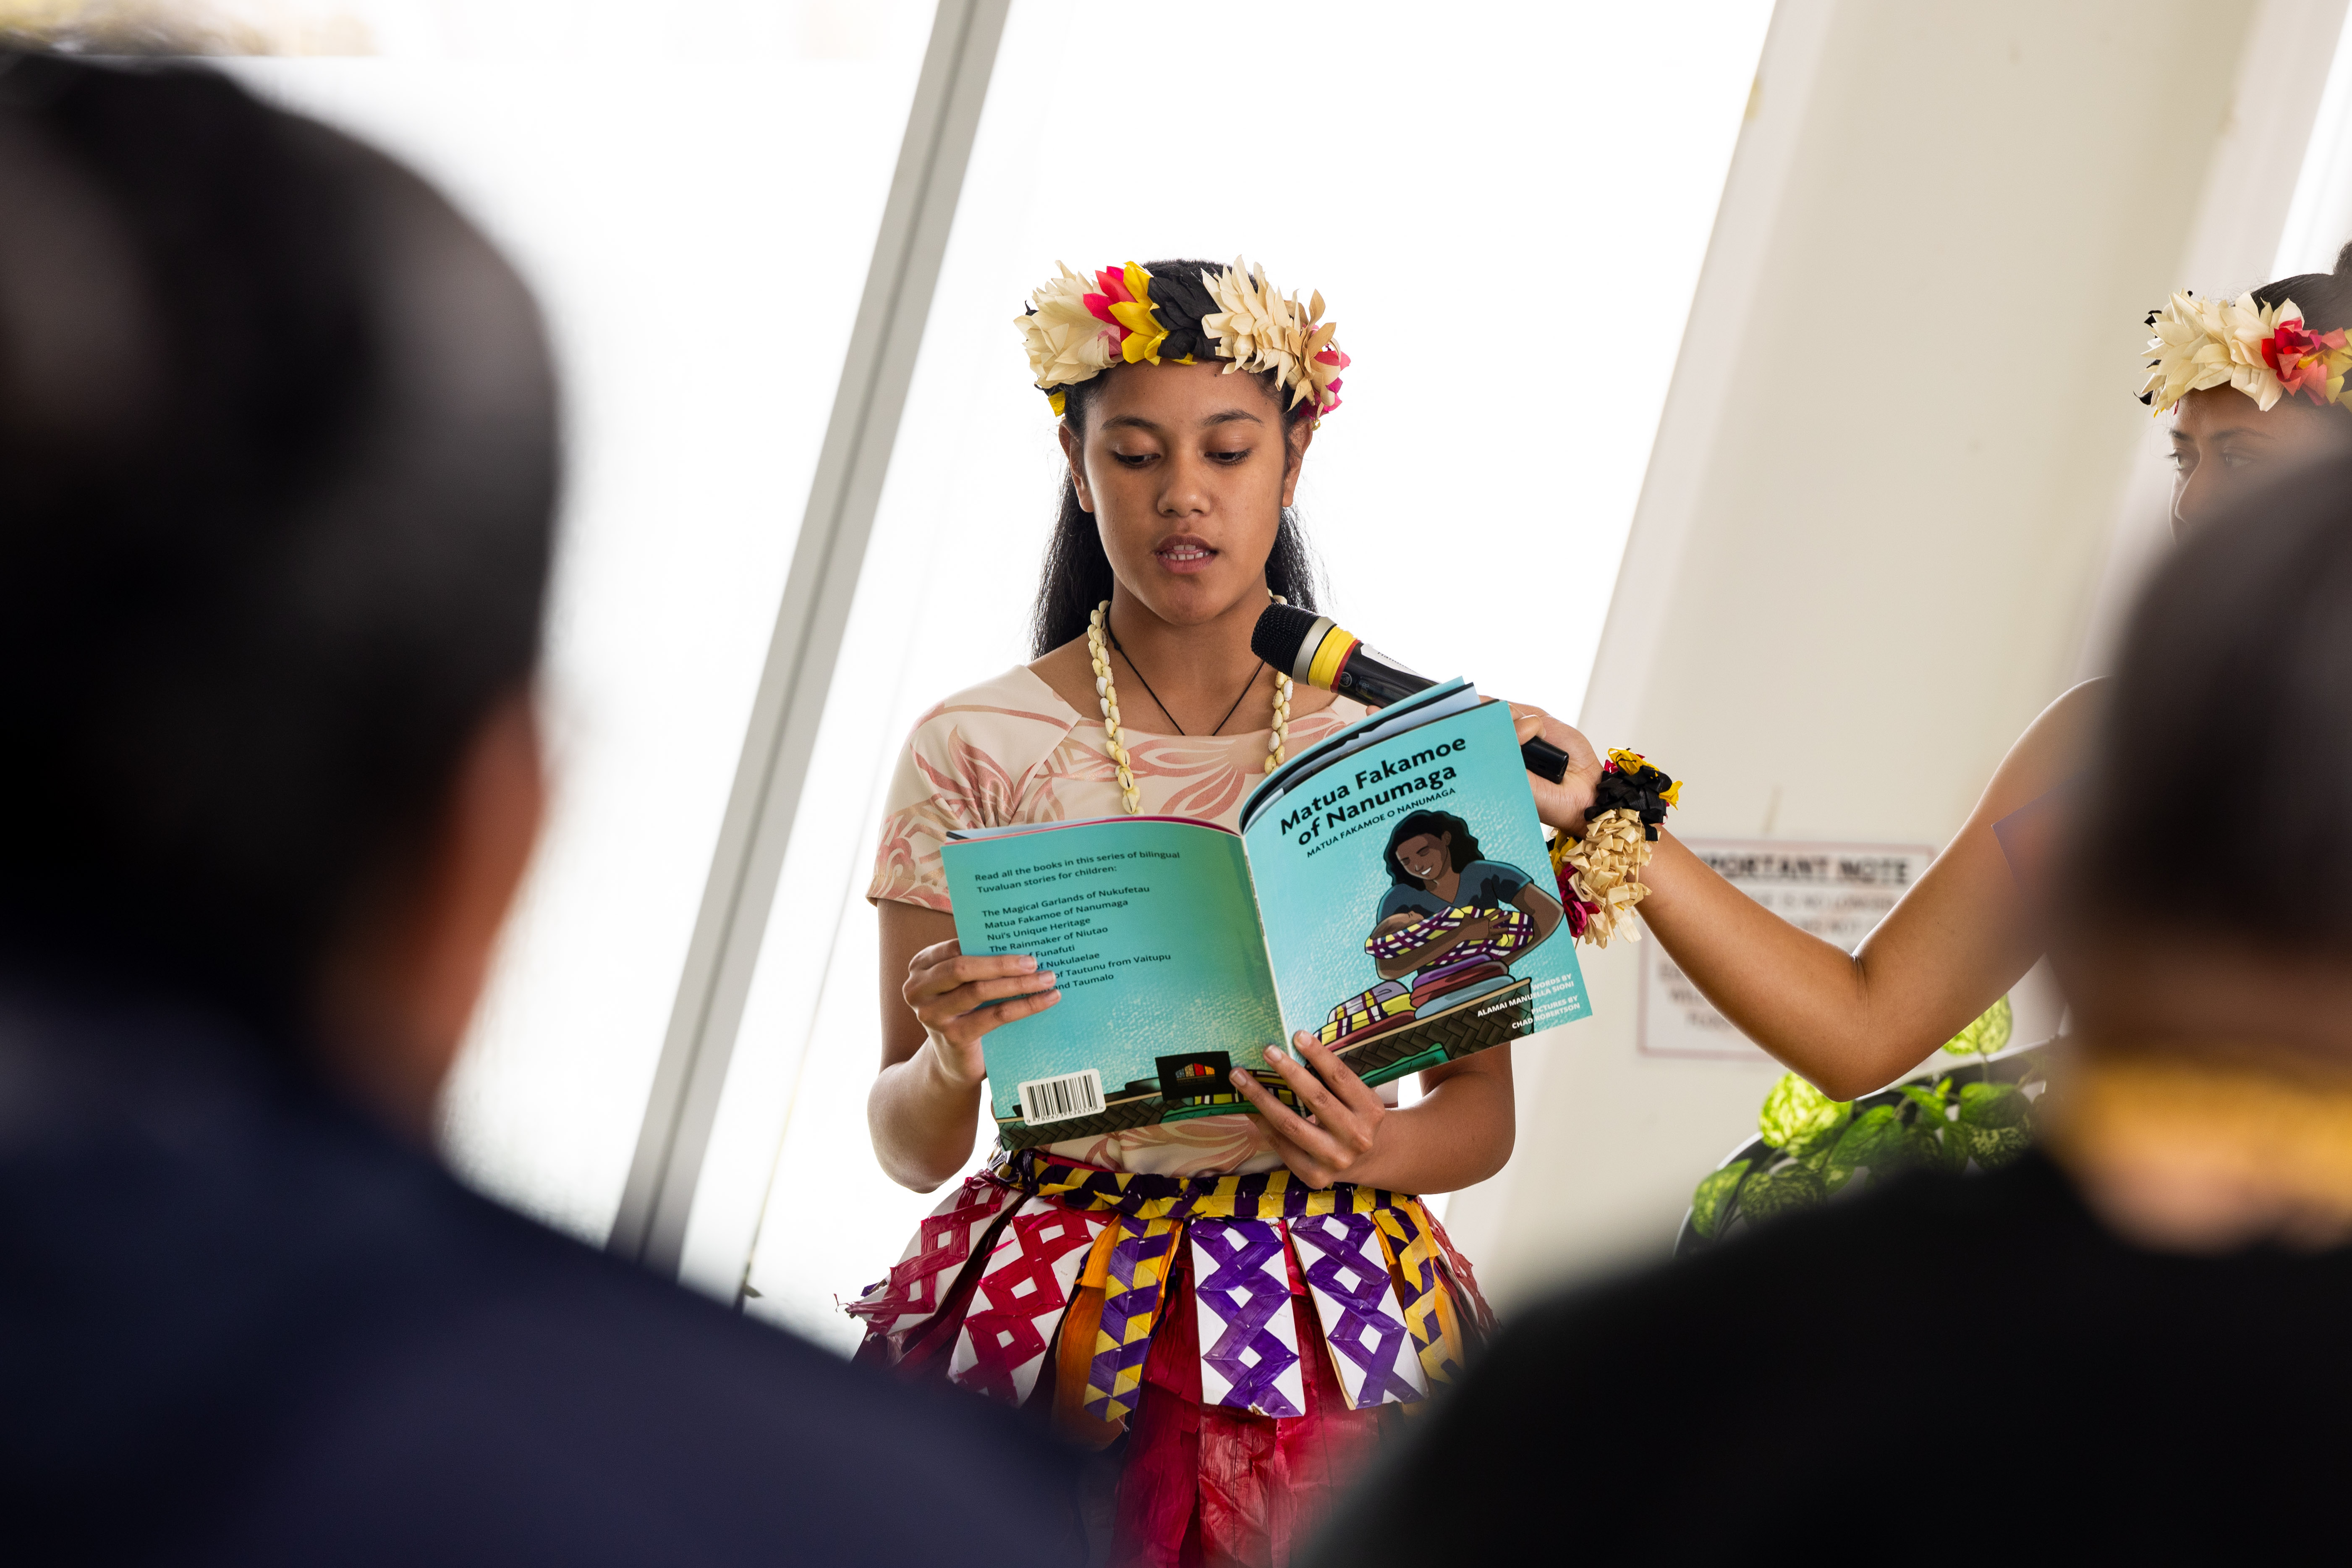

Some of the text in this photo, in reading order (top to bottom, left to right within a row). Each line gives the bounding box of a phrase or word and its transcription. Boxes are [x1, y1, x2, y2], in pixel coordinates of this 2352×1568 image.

[1280, 738, 1466, 835] Matua Fakamoe
[1298, 766, 1457, 846] of Nanumaga
[1307, 836, 1339, 858] MATUA
[1340, 814, 1386, 839] FAKAMOE
[1397, 787, 1456, 814] NANUMAGA
[975, 872, 999, 881] Read
[1033, 862, 1062, 872] books
[1139, 851, 1180, 859] bilingual
[1840, 858, 1908, 885] NOTE
[977, 882, 1021, 893] Tuvaluan
[1024, 875, 1056, 886] stories
[1075, 866, 1117, 877] children:
[1002, 902, 1039, 915] Magical
[1041, 894, 1084, 907] Garlands
[1099, 887, 1150, 897] Nukufetau
[985, 920, 1015, 929] Matua
[1018, 911, 1061, 924] Fakamoe
[1076, 900, 1128, 913] Nanumaga
[1013, 926, 1048, 937] Unique
[1050, 918, 1091, 931] Heritage
[1010, 936, 1061, 950] Rainmaker
[1076, 927, 1108, 938] Niutao
[1036, 945, 1075, 958] Funafuti
[1046, 953, 1100, 968] Nukulaelae
[1065, 964, 1106, 976] Tautunu
[1108, 959, 1131, 968] from
[1133, 954, 1171, 963] Vaitupu
[1072, 974, 1114, 987] Taumalo
[1532, 973, 1572, 991] WORDS BY
[1478, 981, 1574, 1017] ALAMAI MANUELLA SIONI
[1531, 995, 1578, 1015] PICTURES BY
[1512, 1003, 1580, 1029] CHAD ROBERTSON
